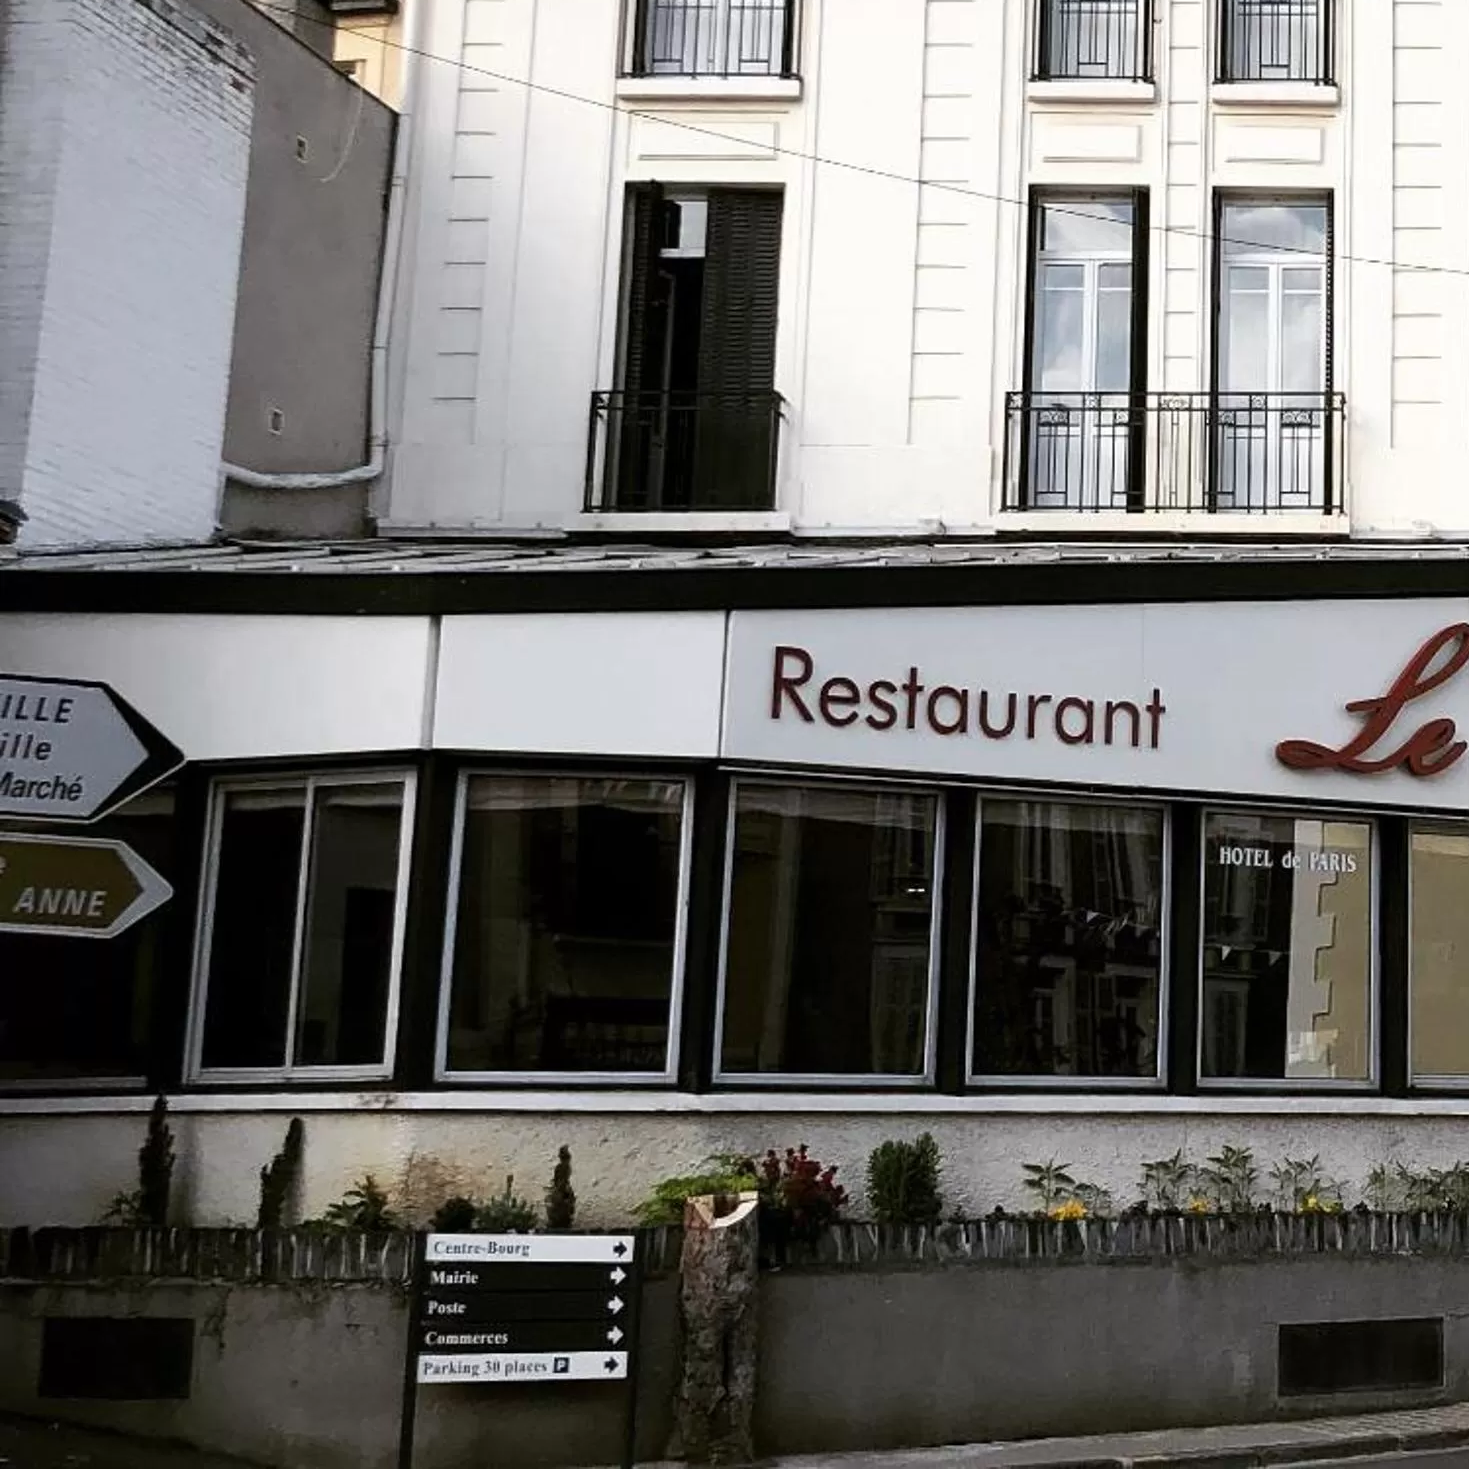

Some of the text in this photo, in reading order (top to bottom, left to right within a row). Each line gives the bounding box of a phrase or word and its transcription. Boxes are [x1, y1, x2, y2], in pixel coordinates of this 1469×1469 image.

[770, 645, 1167, 750] Restaurant
[0, 692, 75, 724] ILLE
[1219, 846, 1357, 873] HOTEL de PARIS
[13, 886, 107, 917] ANNE
[434, 1241, 531, 1257] Centre-Bourg
[430, 1270, 479, 1285] Mairie
[428, 1300, 467, 1315] Poste
[424, 1331, 509, 1346] Commerces
[423, 1361, 480, 1377] Parking
[484, 1360, 500, 1373] 30
[504, 1360, 548, 1377] places
